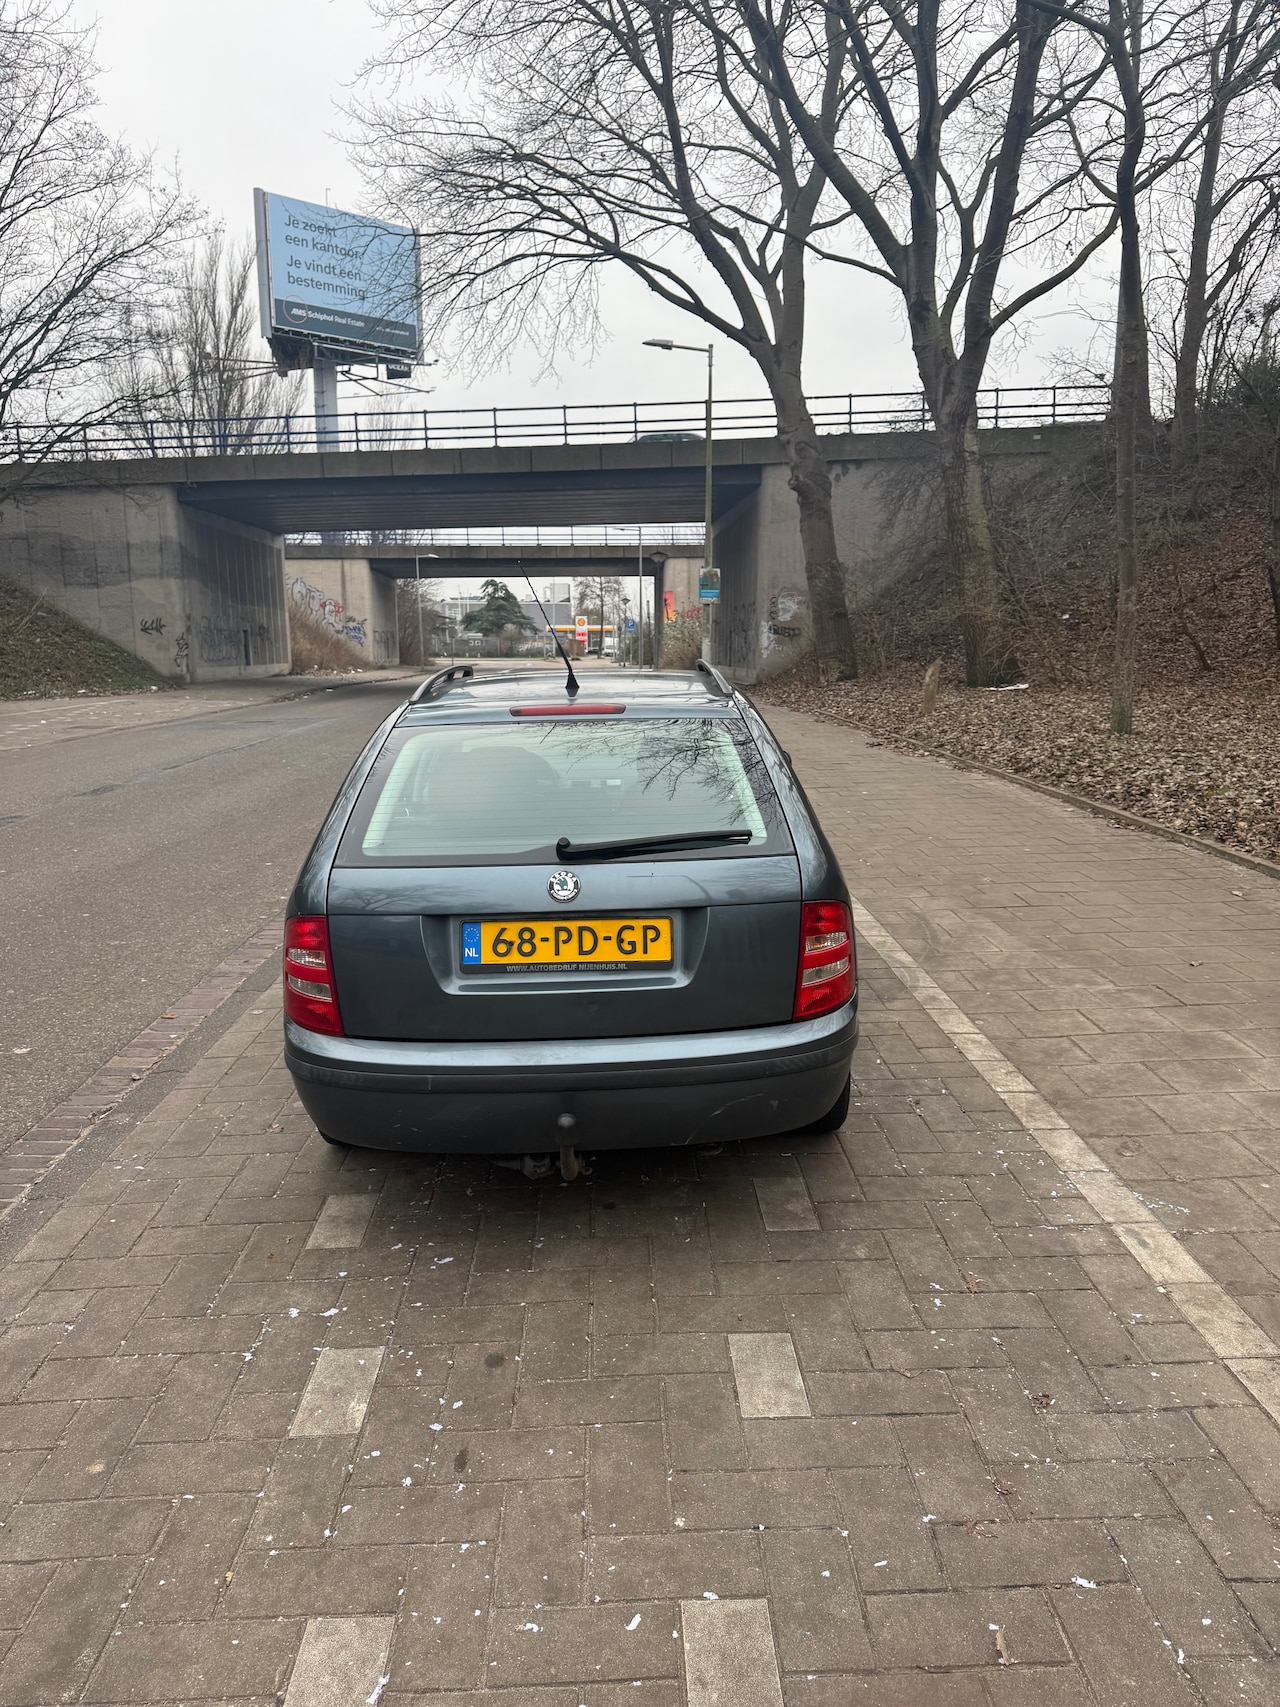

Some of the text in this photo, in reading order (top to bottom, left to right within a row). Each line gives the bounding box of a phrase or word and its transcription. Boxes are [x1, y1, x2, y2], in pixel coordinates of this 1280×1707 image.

[284, 215, 337, 238] Je zoekt
[285, 234, 309, 248] een
[286, 255, 362, 281] Je vindt een
[307, 310, 334, 322] Schiphol
[334, 315, 347, 325] Real
[347, 318, 366, 328] Estate
[464, 924, 661, 957] NL 68-PD-GP
